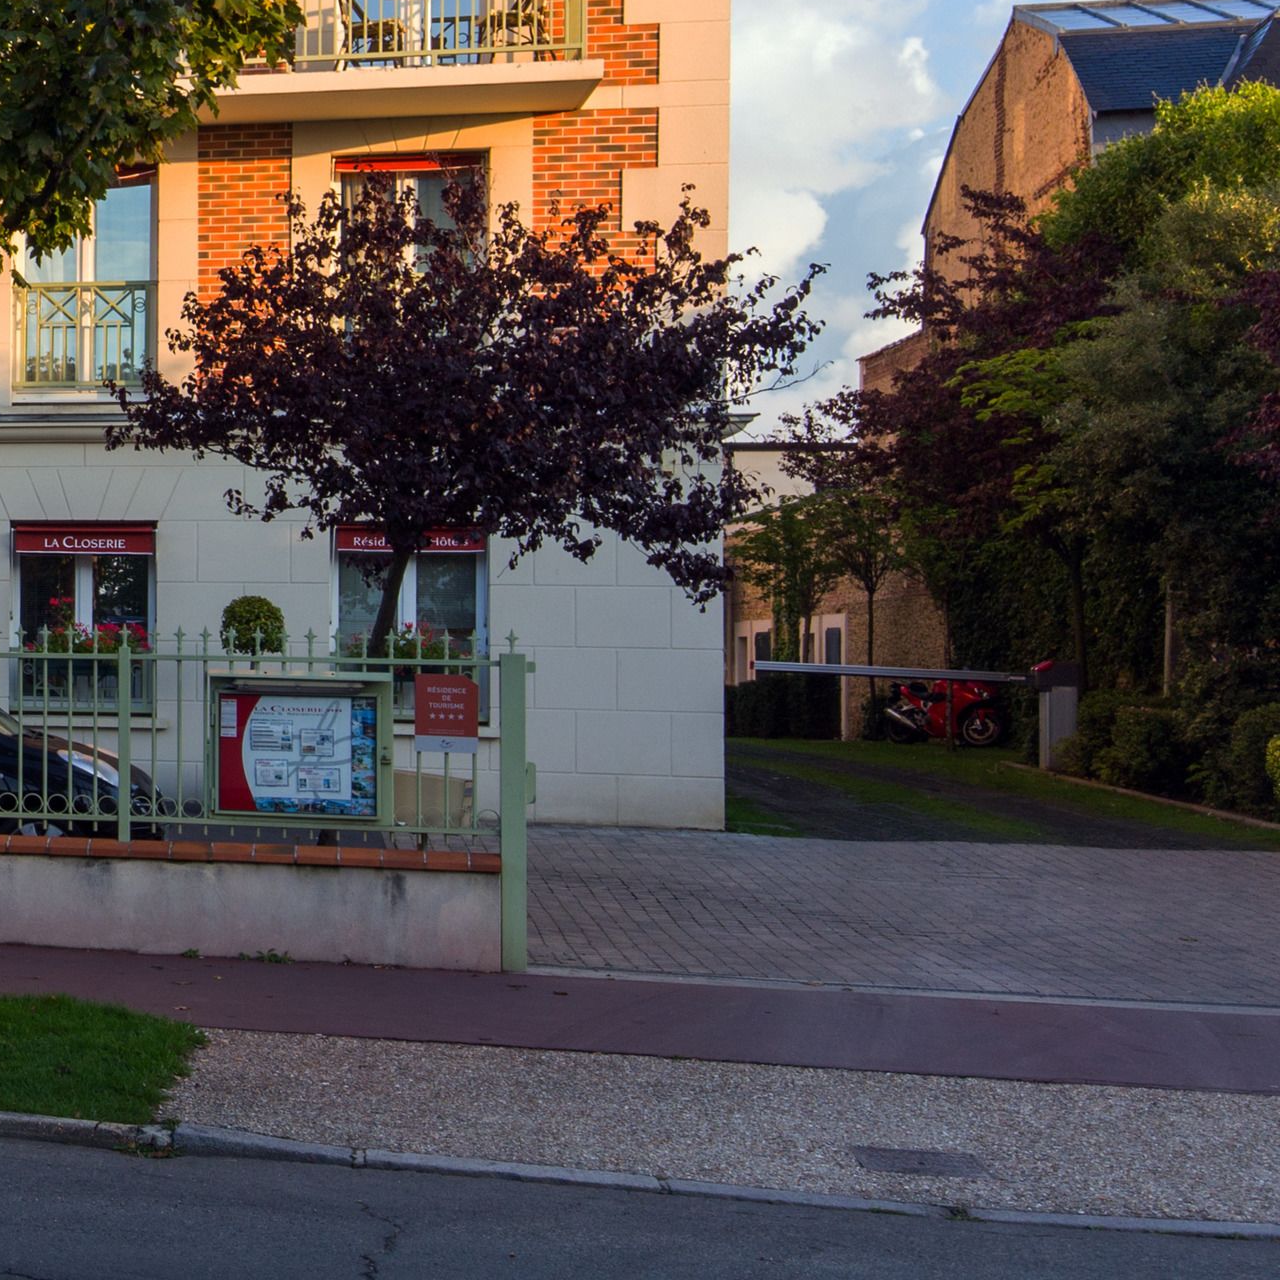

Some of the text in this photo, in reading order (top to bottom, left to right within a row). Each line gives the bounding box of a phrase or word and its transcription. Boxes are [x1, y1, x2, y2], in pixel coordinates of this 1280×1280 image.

[44, 535, 126, 549] LA CLOSERIE
[426, 686, 467, 694] RÉSIDENCE
[441, 694, 452, 702] DE
[428, 702, 465, 710] TOURISME
